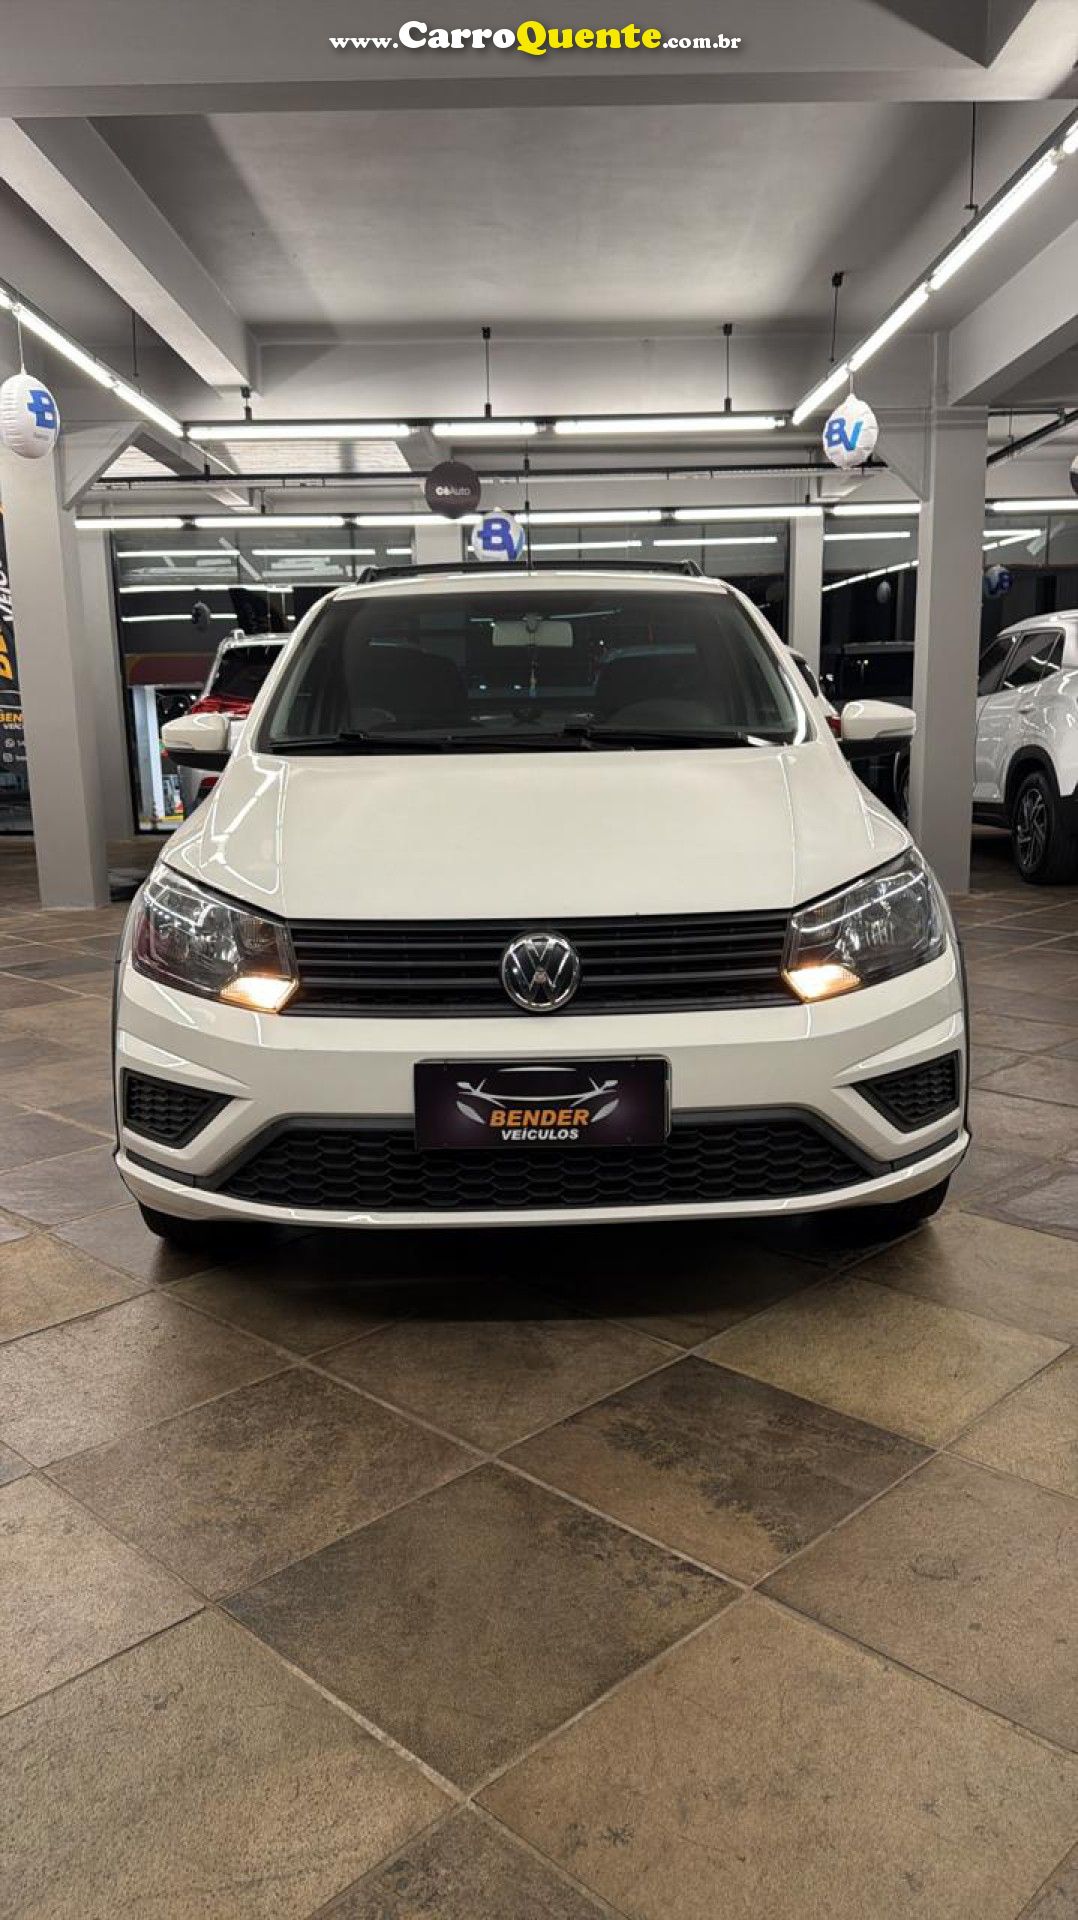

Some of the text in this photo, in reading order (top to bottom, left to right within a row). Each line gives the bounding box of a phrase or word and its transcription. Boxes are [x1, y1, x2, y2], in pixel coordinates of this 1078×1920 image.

[825, 418, 864, 451] BV
[489, 1109, 590, 1127] BENDER
[501, 1127, 580, 1141] VEÍCULOS
